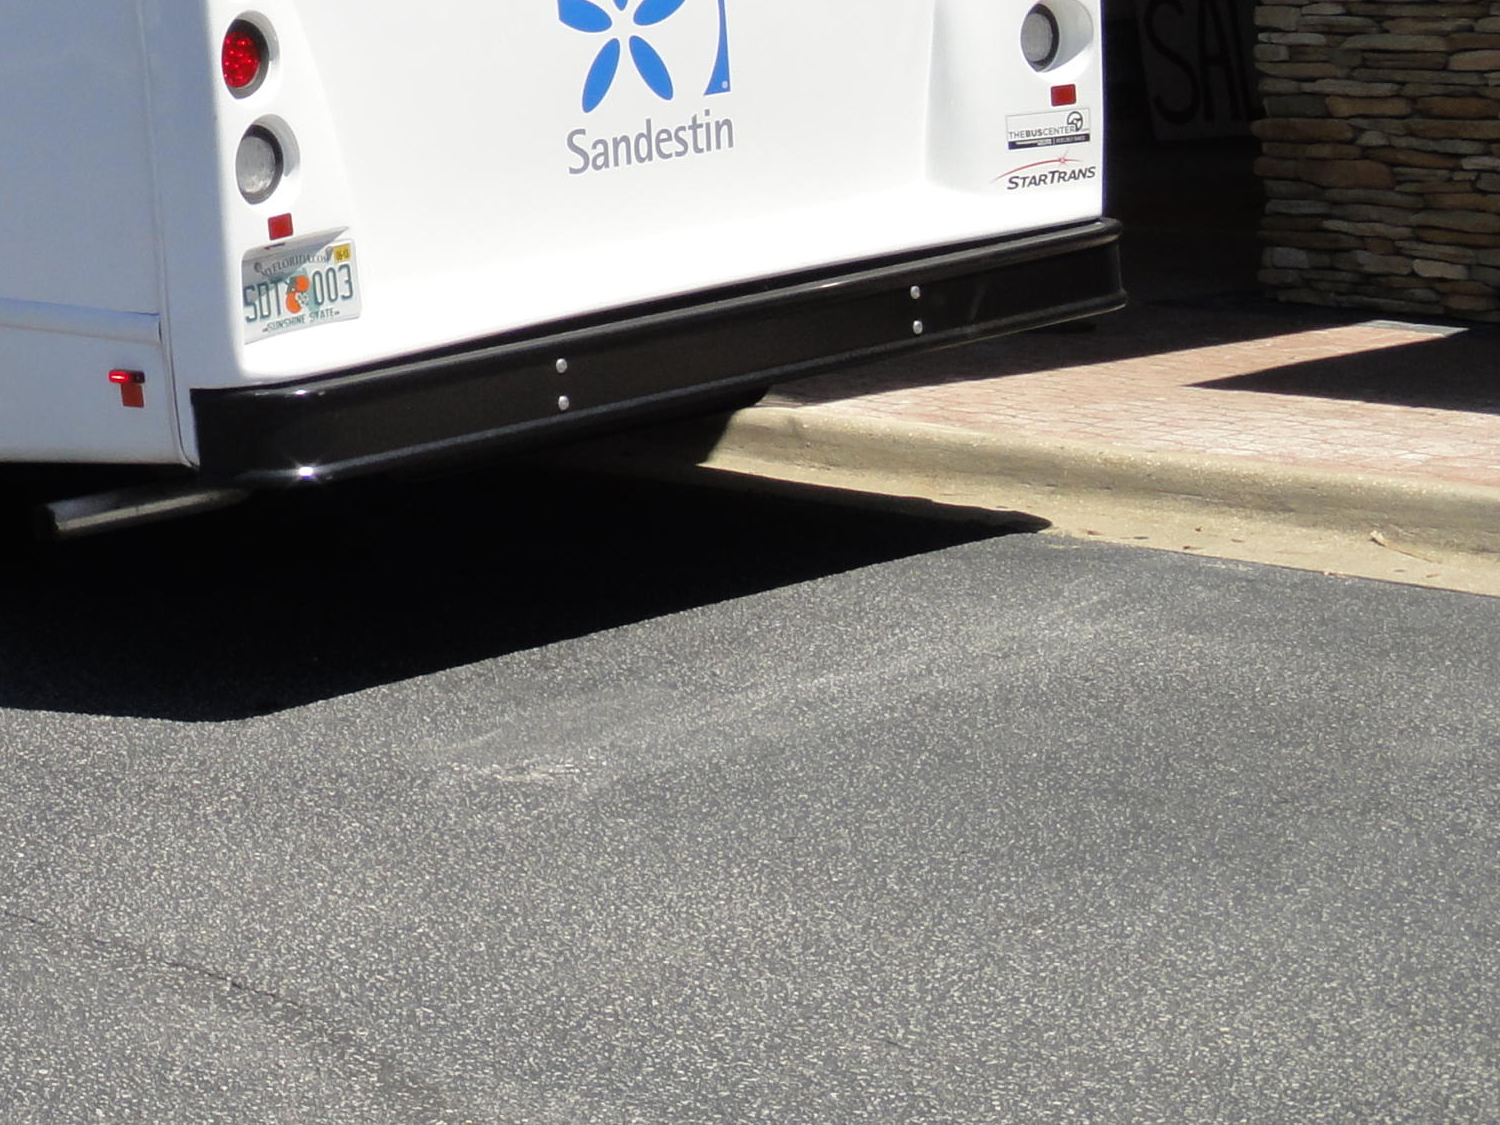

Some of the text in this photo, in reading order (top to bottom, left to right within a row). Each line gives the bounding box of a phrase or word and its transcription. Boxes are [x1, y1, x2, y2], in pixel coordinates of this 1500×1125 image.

[566, 108, 734, 175] Sandestin
[312, 263, 354, 306] 003
[267, 307, 335, 331] SUNSHINE STATE
